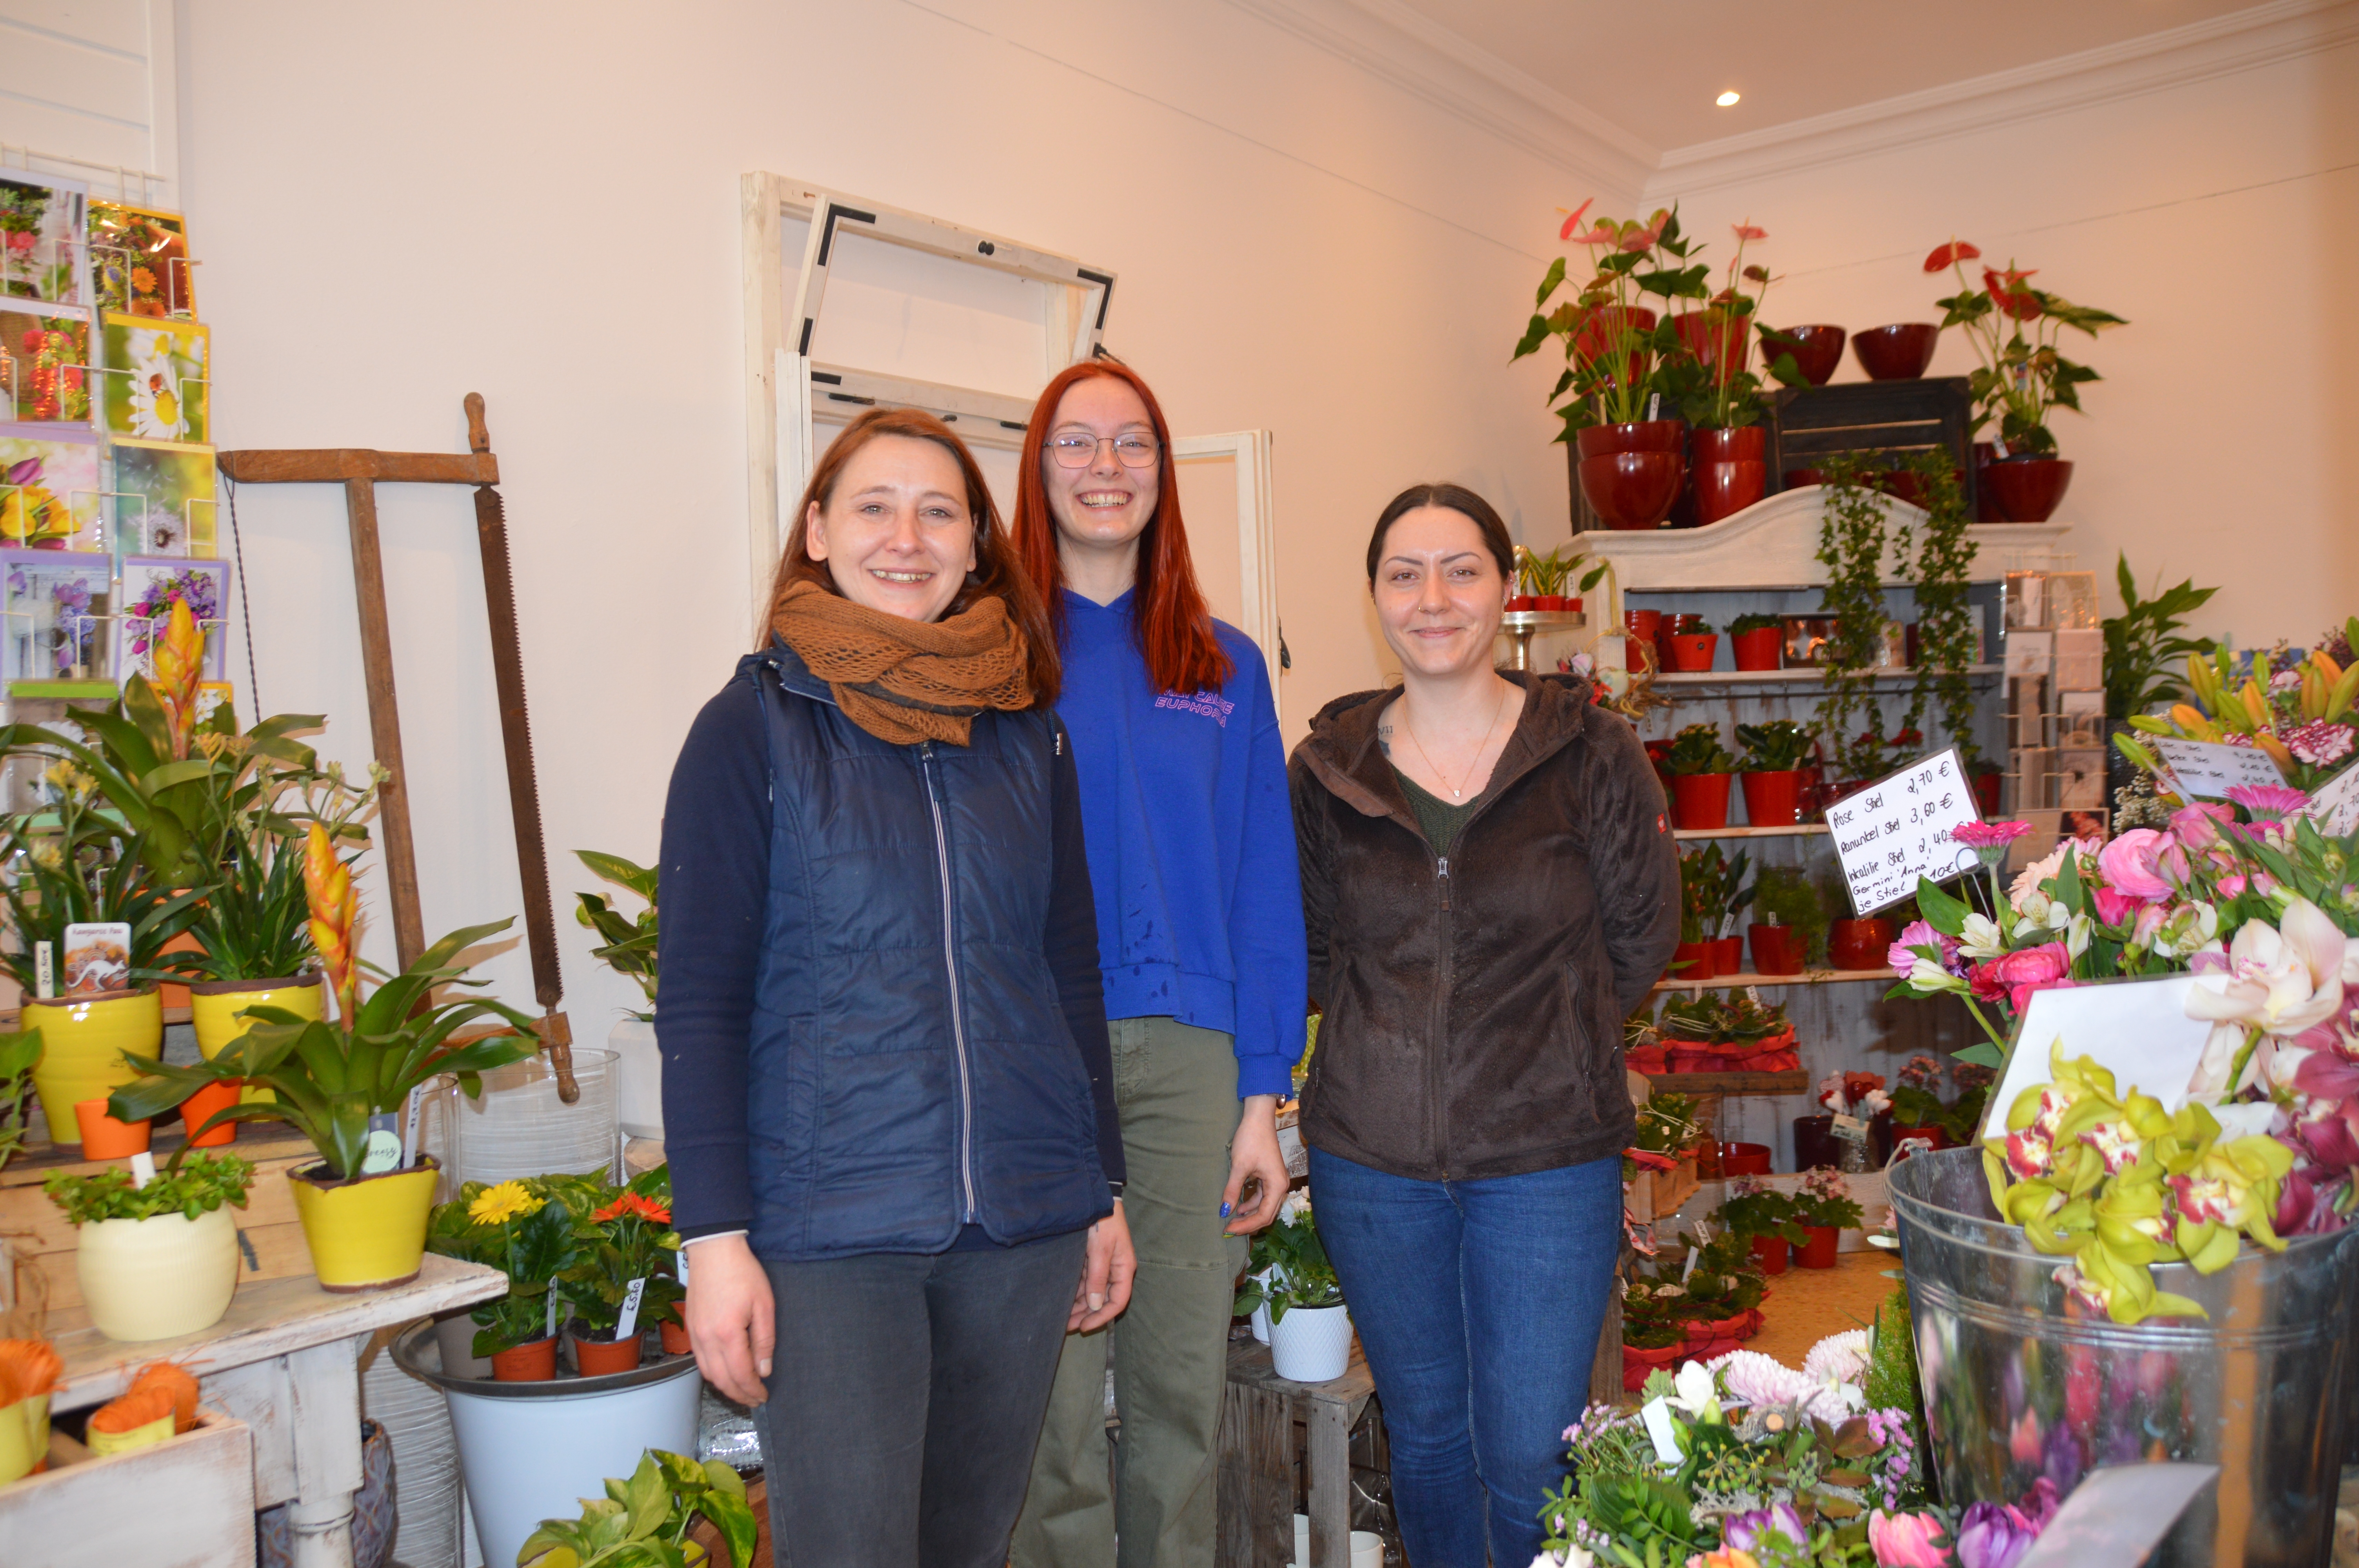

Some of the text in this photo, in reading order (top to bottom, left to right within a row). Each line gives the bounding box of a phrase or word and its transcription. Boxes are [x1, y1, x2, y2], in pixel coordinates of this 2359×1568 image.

[1155, 697, 1226, 728] EUPHORIA
[1194, 691, 1235, 714] CAUSE
[1833, 760, 1950, 829] Rose Stiel 2,70 €
[1841, 793, 1953, 855] Ranunkel Stiel 3,60 €
[1888, 847, 1905, 866] Stiel
[1919, 829, 1947, 854] 2,40
[1852, 871, 1893, 895] Germini
[1858, 900, 1872, 912] je
[1876, 881, 1905, 901] Stiel
